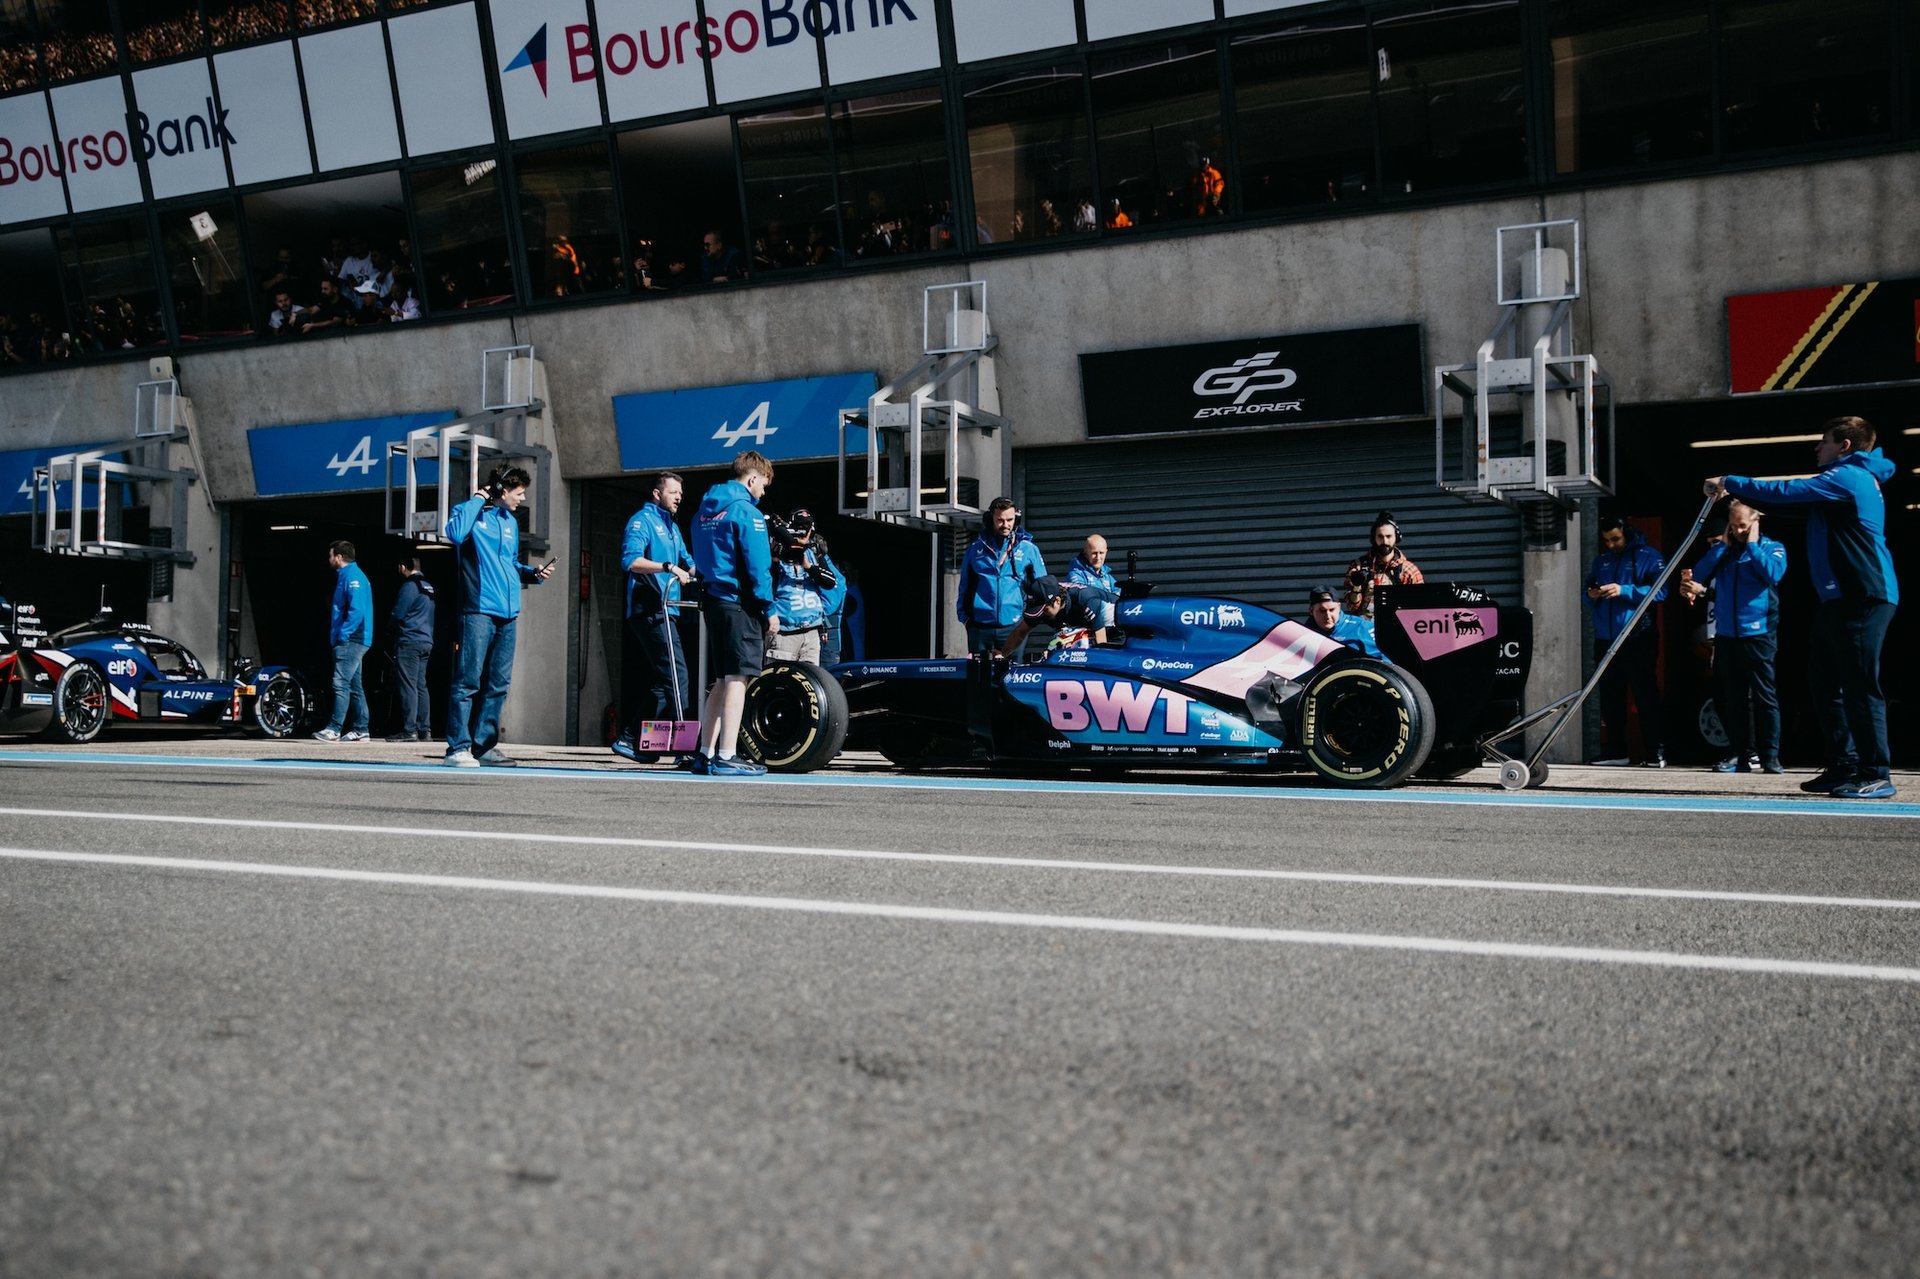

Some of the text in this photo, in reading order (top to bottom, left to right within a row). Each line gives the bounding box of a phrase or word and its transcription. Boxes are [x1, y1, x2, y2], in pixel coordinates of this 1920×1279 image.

[0, 97, 237, 186] BoursoBank
[1193, 401, 1302, 419] EXPLORER
[1180, 607, 1215, 625] eni
[1414, 614, 1449, 634] eni
[122, 623, 151, 631] ALPINE
[108, 660, 127, 675] elf
[1155, 659, 1194, 670] ApeCoin
[1013, 673, 1042, 683] MSC
[163, 689, 214, 701] ALPINE
[792, 671, 819, 720] ZERO
[1045, 680, 1197, 734] BWT
[654, 723, 686, 731] Microsoft
[1303, 697, 1316, 746] PIRELLI
[1384, 688, 1410, 770] P ZERO
[1048, 740, 1071, 749] Delphi
